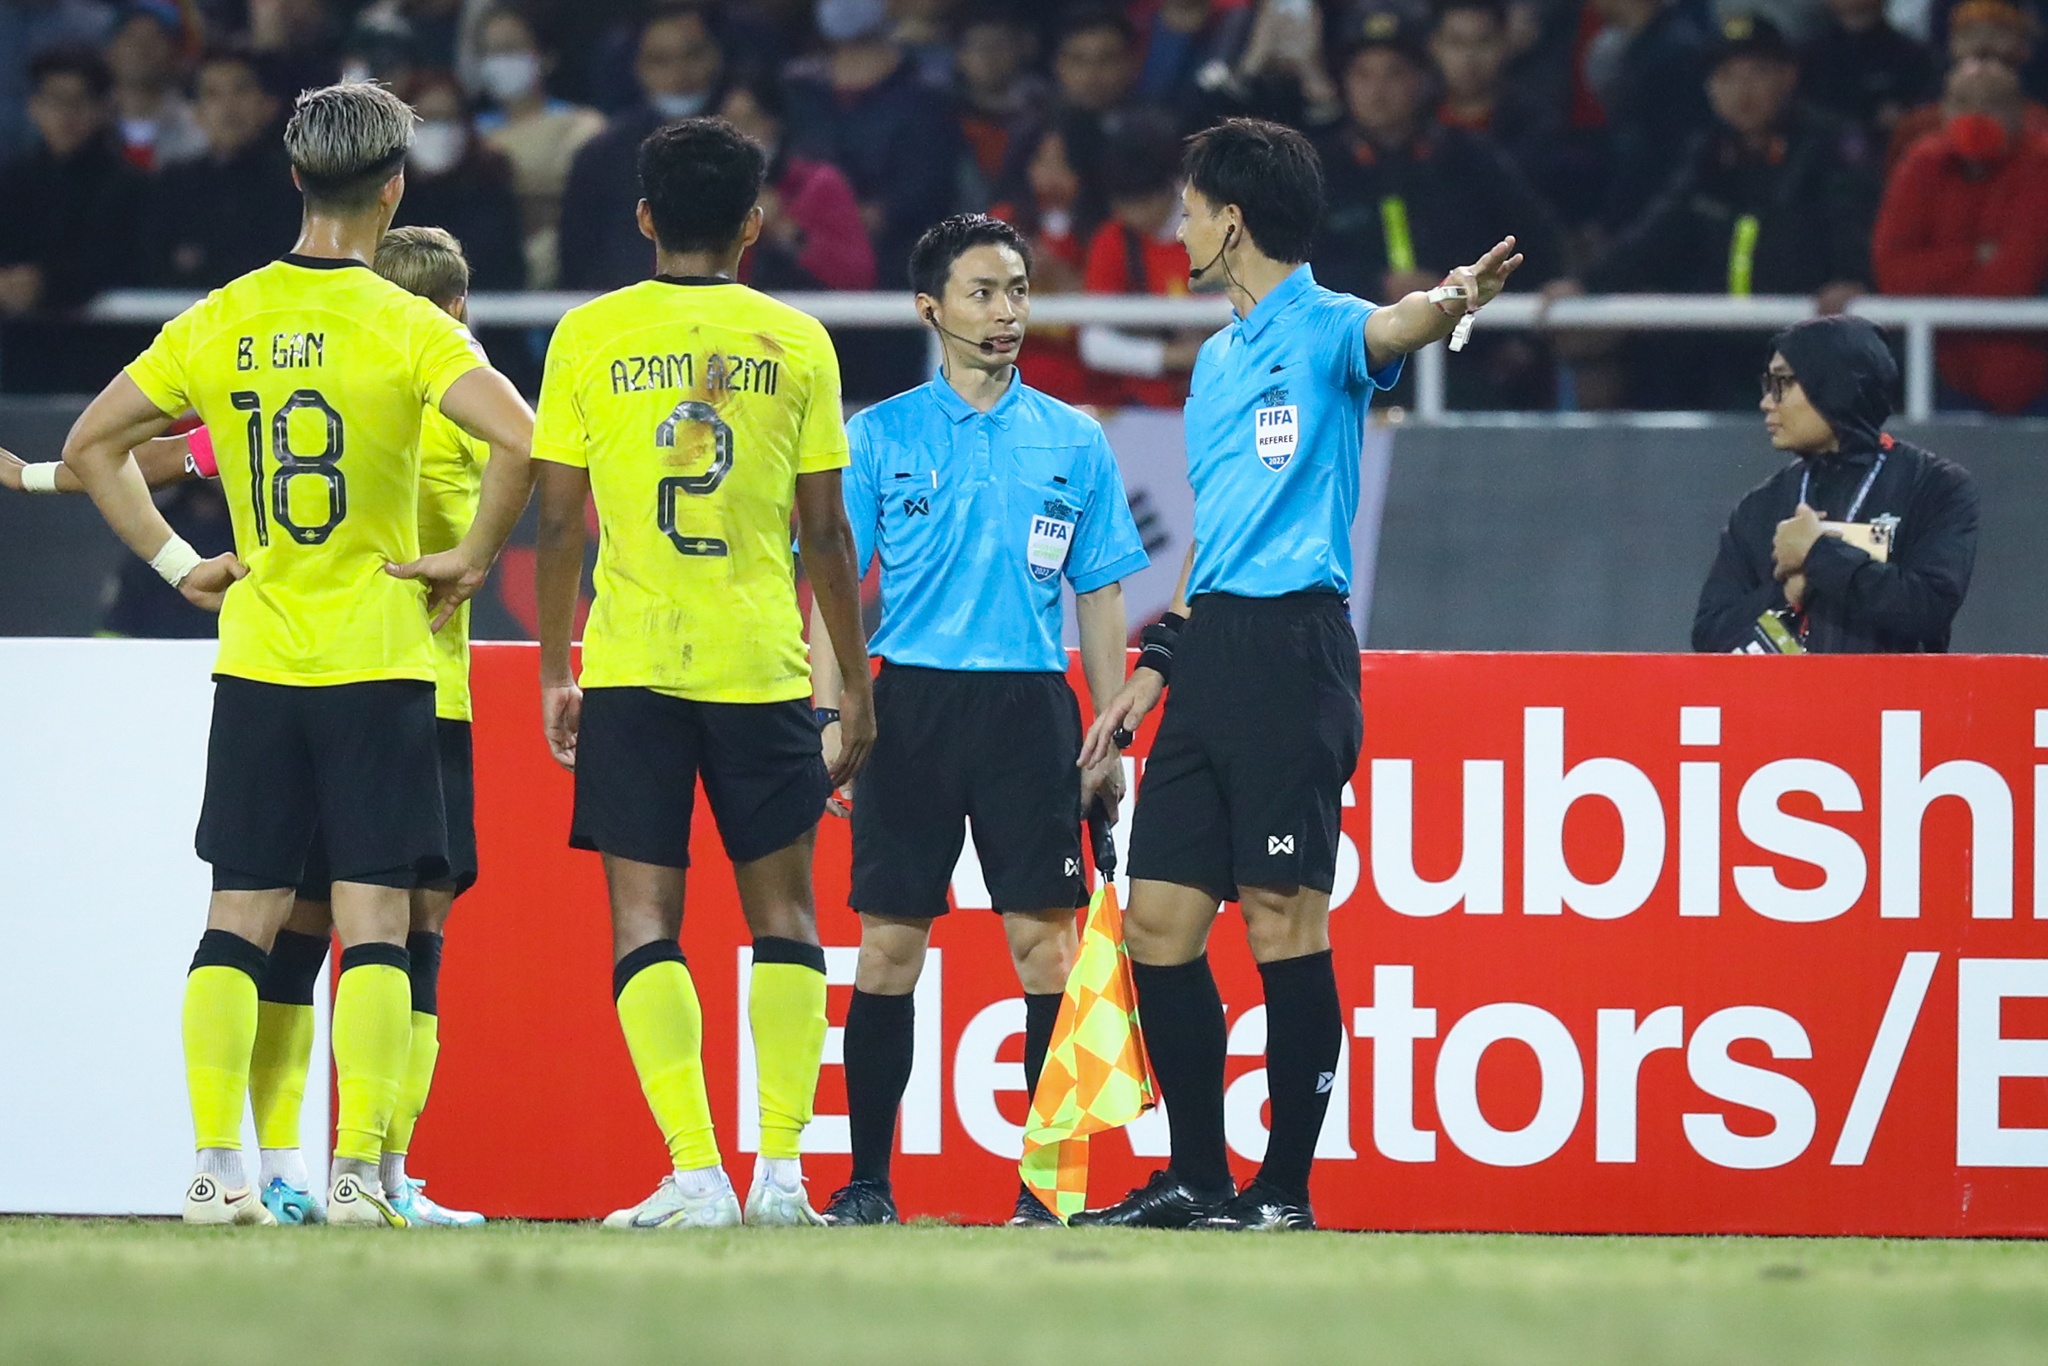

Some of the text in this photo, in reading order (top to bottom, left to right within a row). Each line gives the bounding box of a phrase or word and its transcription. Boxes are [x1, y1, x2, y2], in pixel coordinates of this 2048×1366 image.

[237, 332, 325, 371] B. GAN
[610, 353, 780, 396] AZAM AZMI
[1259, 409, 1293, 427] FIFA
[1259, 434, 1294, 446] REFEREE
[230, 388, 347, 547] 18
[655, 400, 734, 557] 2
[1268, 456, 1285, 465] 2022
[1034, 518, 1067, 540] FIFA
[950, 706, 2048, 923] ubish
